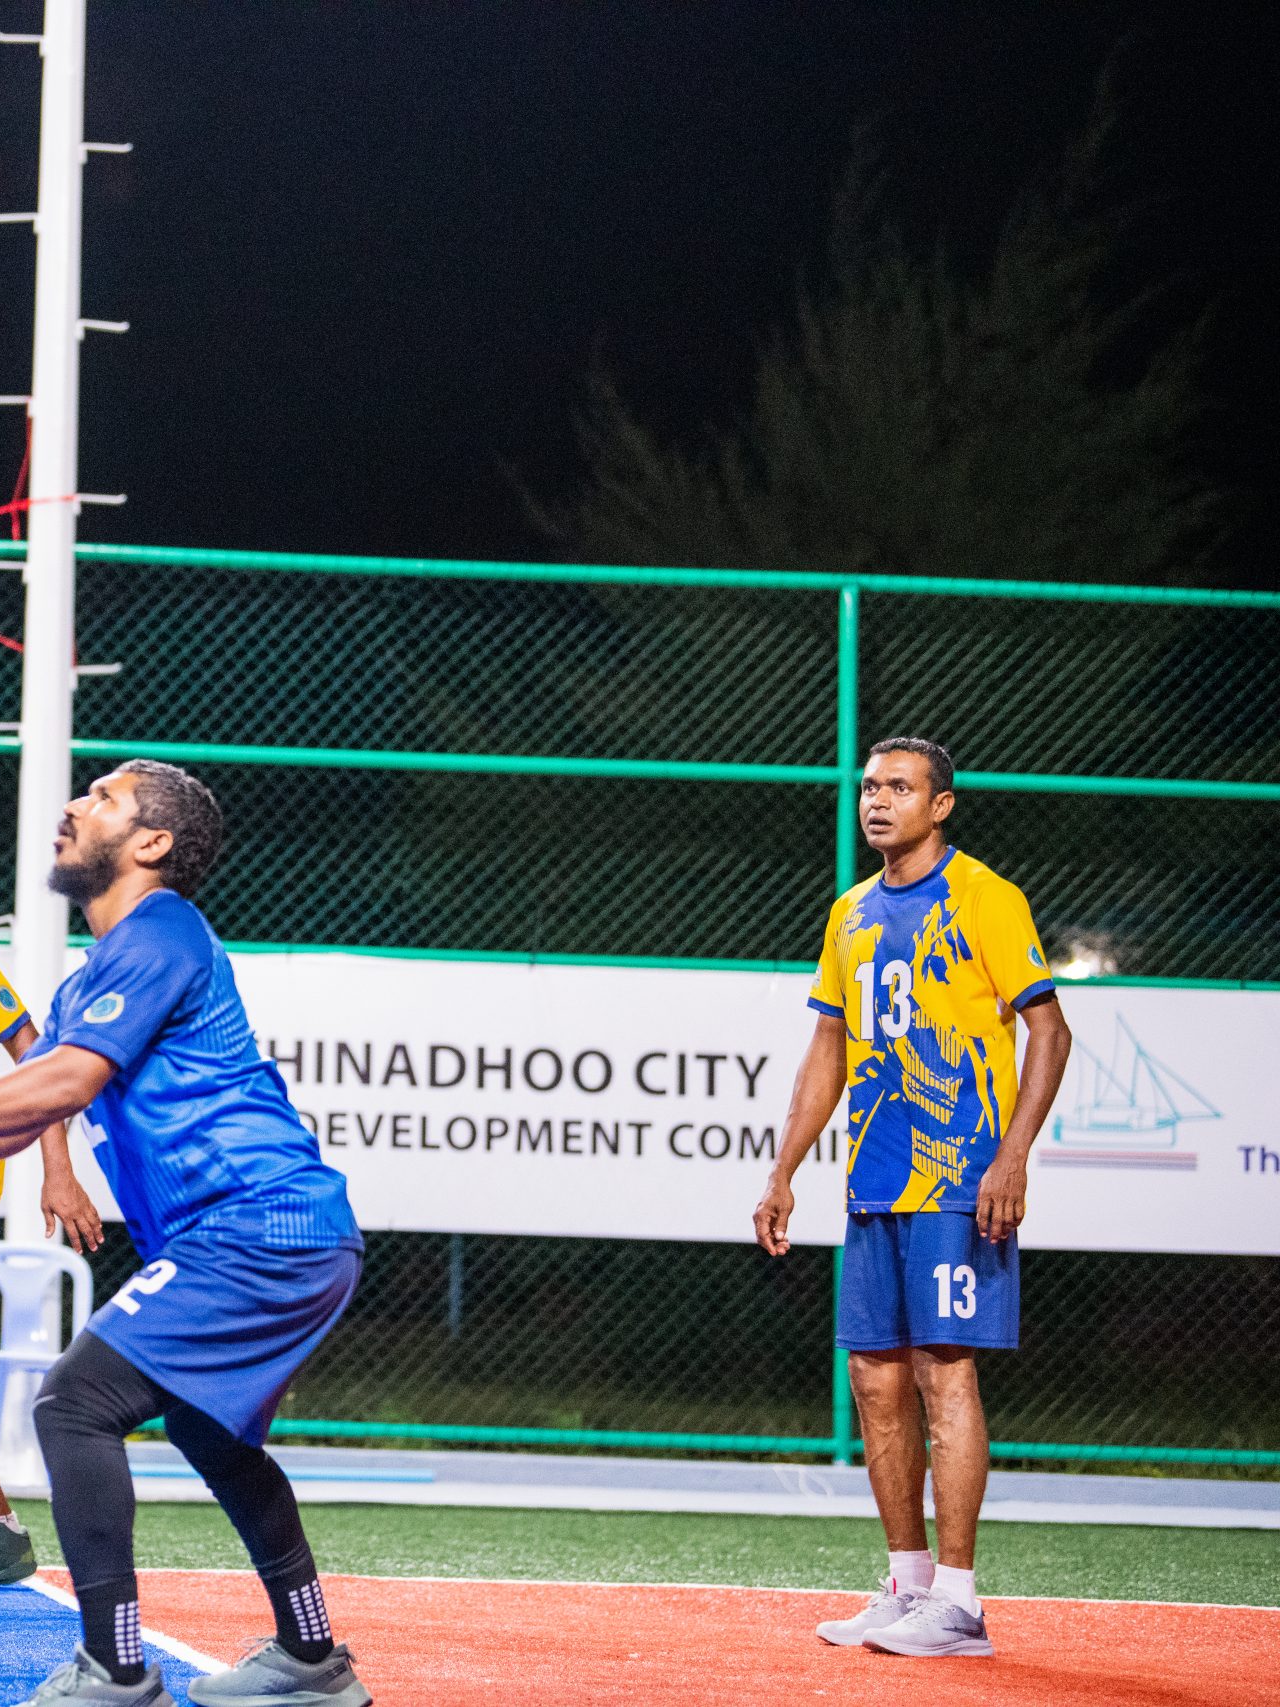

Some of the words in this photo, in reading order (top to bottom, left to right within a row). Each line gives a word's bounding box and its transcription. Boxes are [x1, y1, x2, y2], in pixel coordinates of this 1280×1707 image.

[854, 959, 914, 1040] 13
[255, 1038, 613, 1093] HINADHOO
[634, 1051, 769, 1098] CITY
[111, 1258, 177, 1316] 2
[933, 1263, 977, 1320] 13
